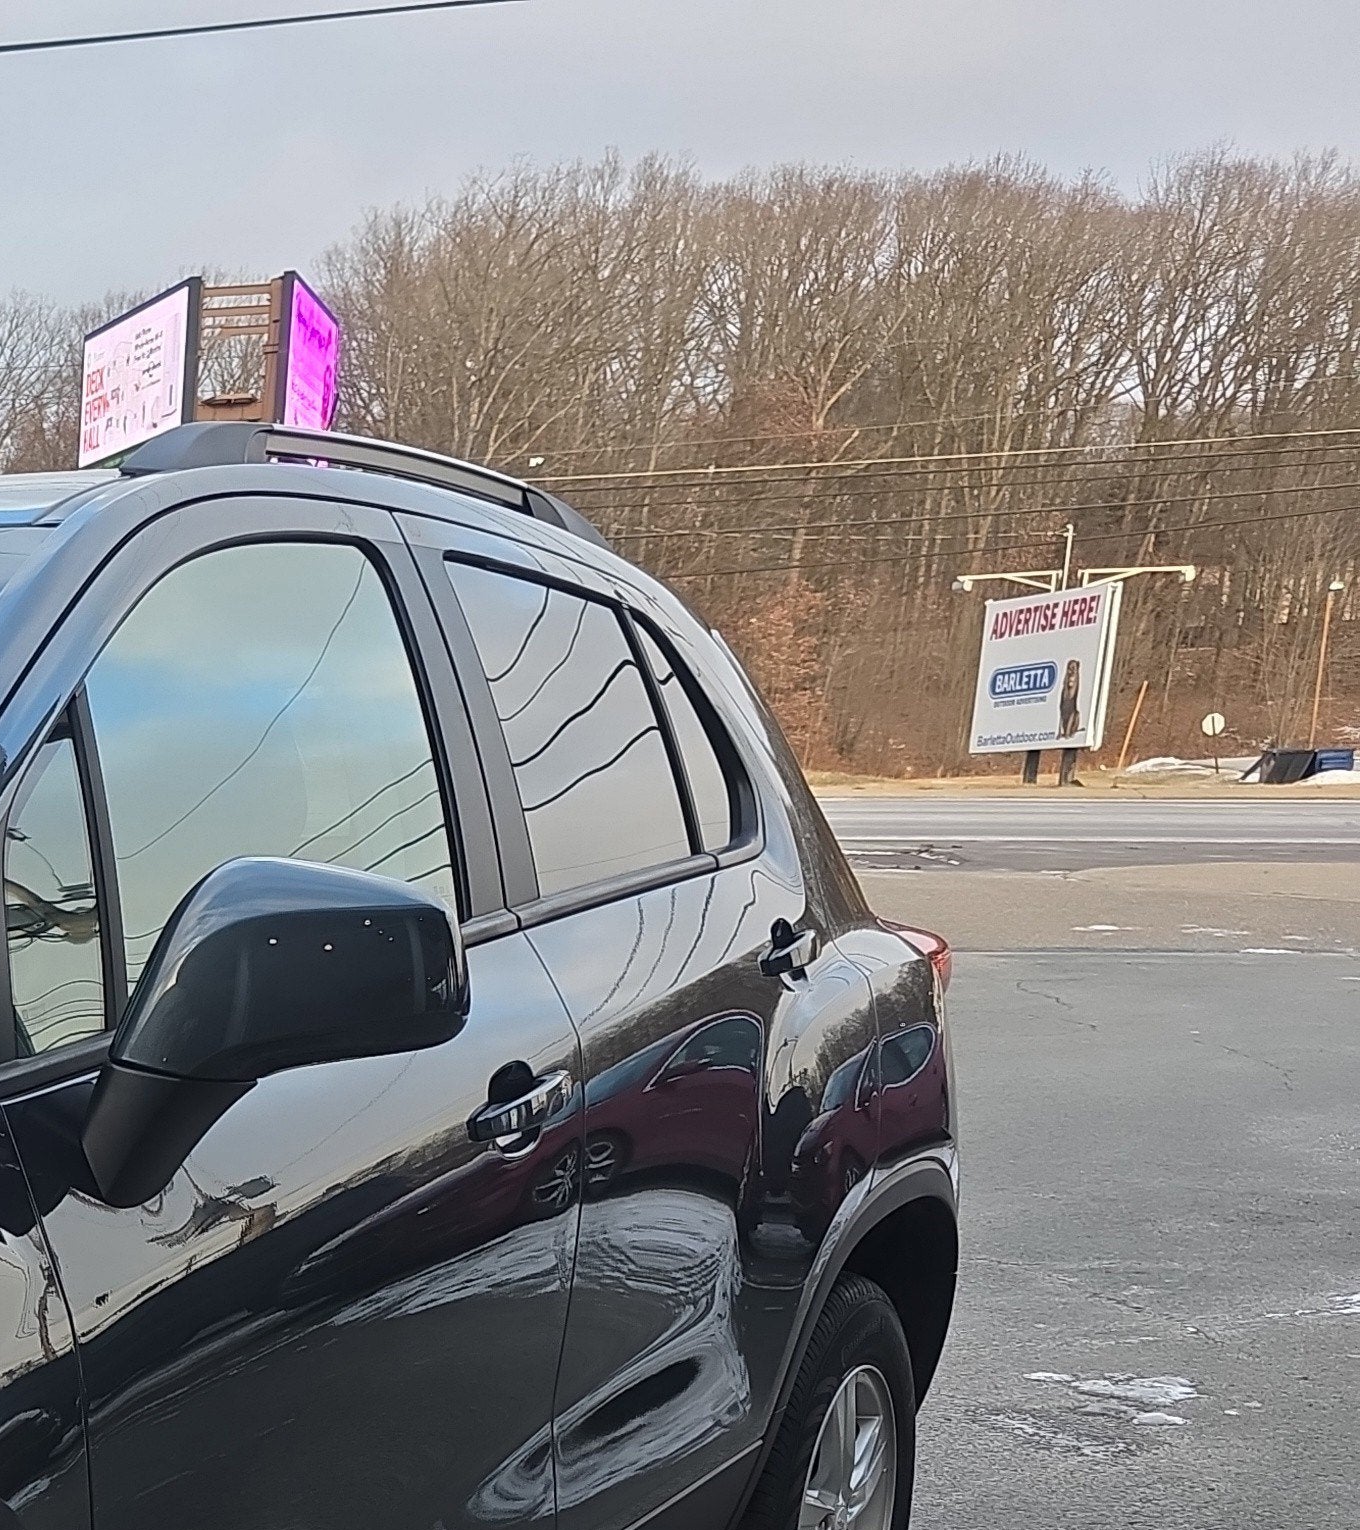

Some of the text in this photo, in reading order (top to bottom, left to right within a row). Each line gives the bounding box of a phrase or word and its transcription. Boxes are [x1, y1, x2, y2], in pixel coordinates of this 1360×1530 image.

[990, 595, 1101, 641] ADVERTISE HERE!
[994, 668, 1049, 693] BARLETTA
[977, 731, 1056, 747] BarlettaOutdoor.com
